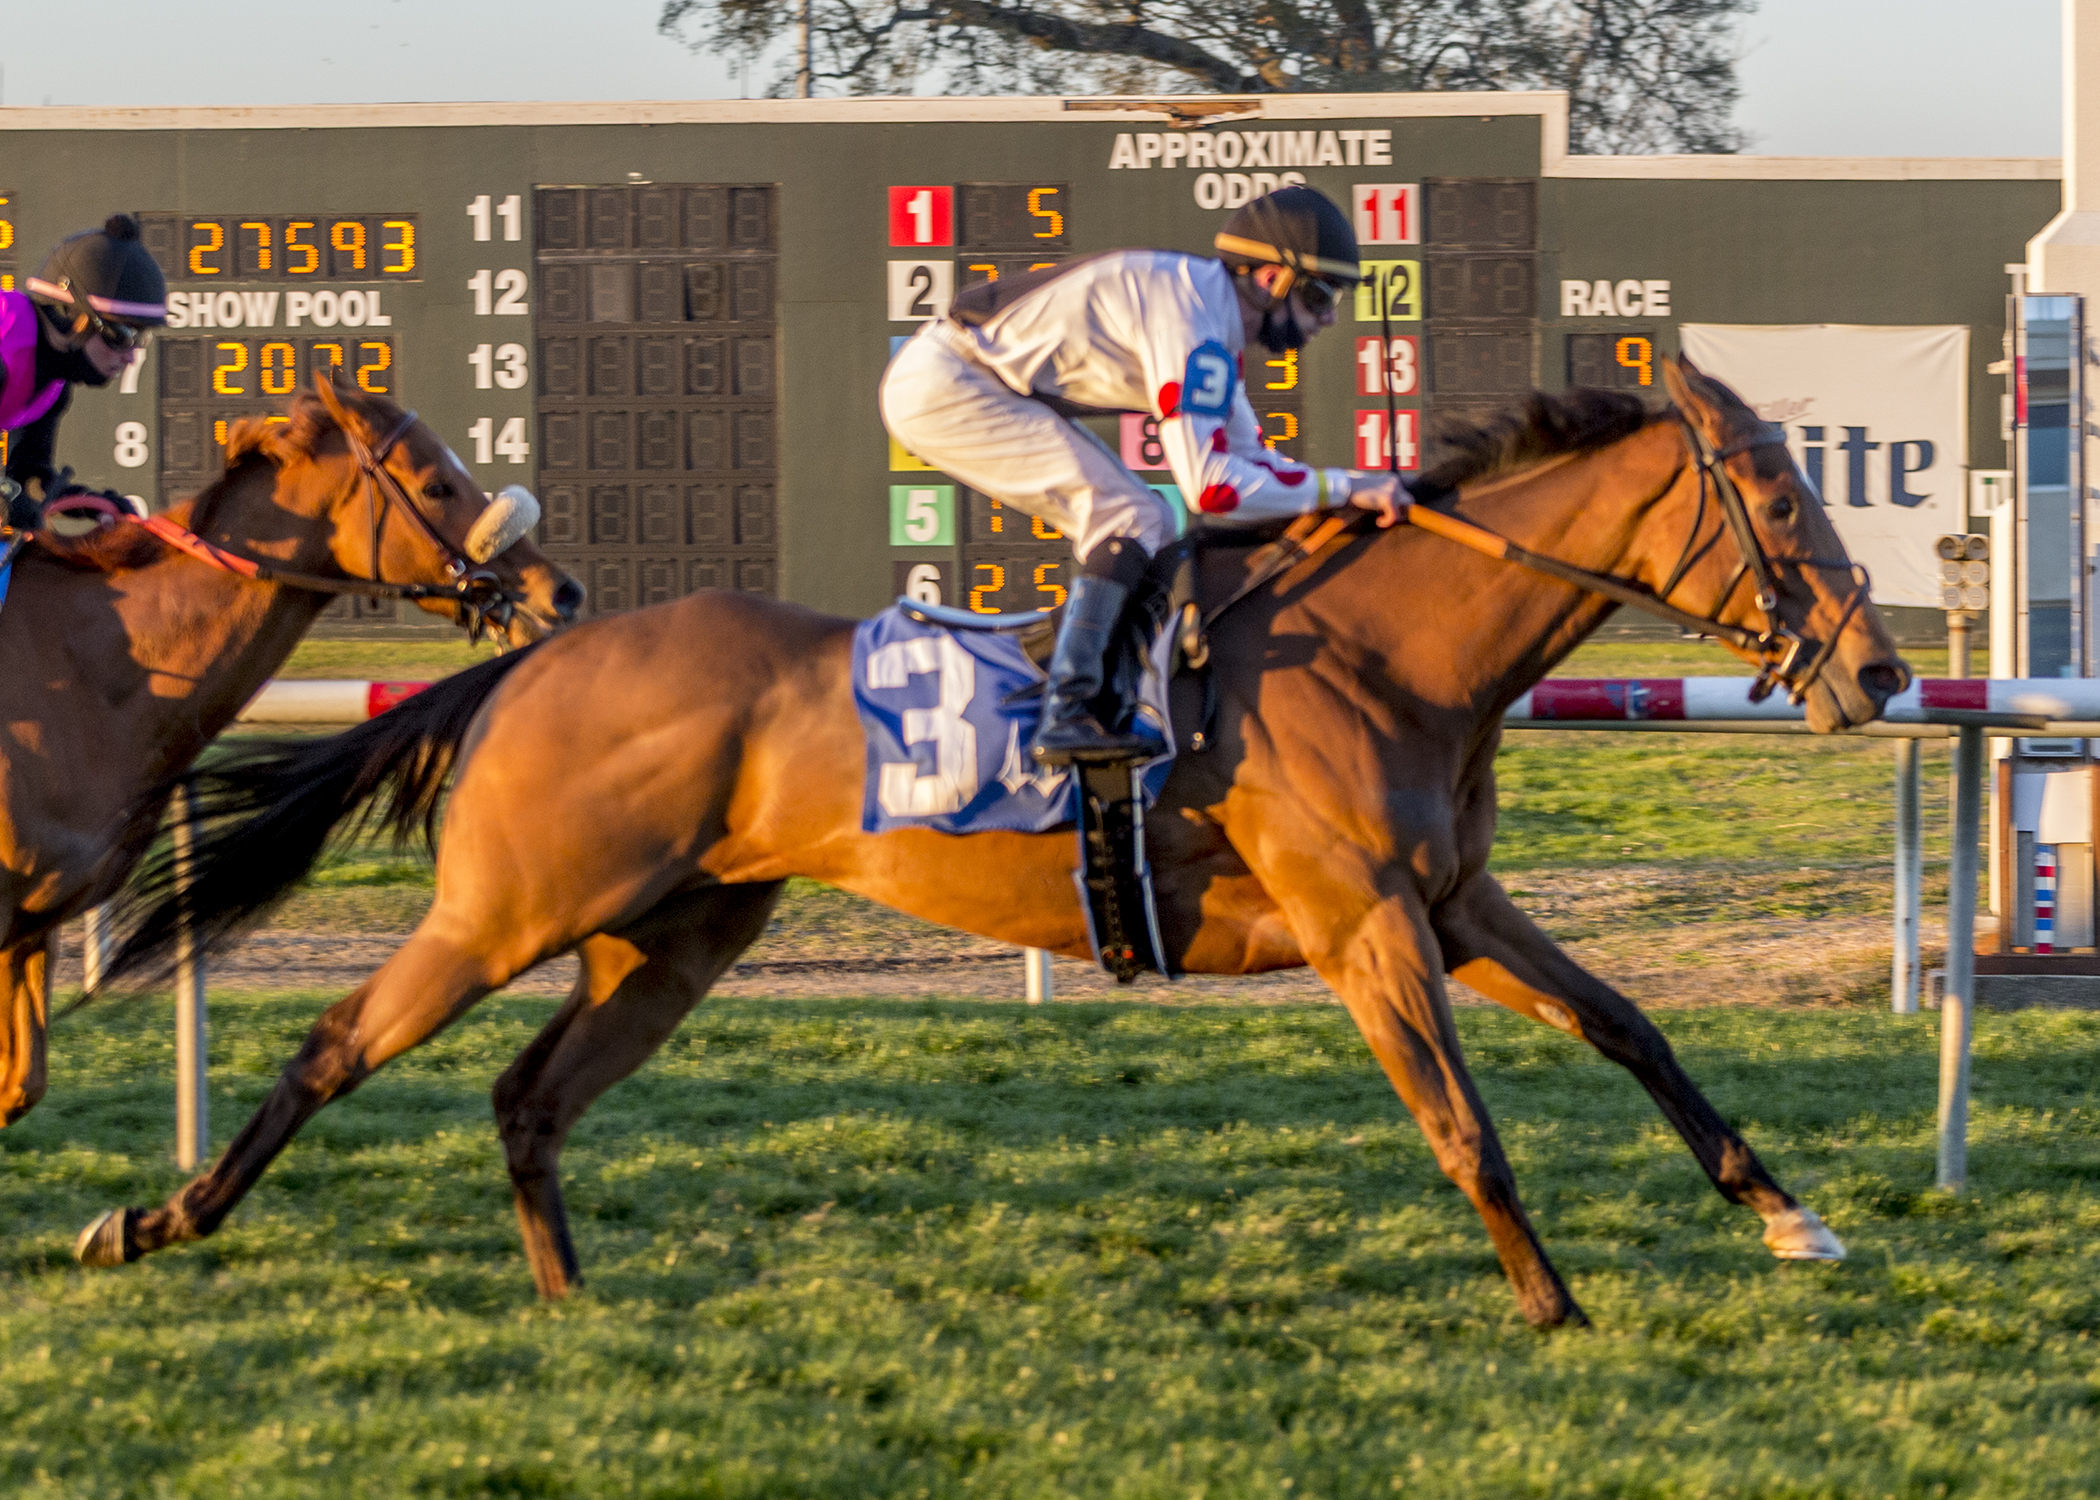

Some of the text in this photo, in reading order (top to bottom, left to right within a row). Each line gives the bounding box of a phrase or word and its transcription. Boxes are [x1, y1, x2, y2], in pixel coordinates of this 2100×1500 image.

[1109, 130, 1392, 169] APPROXIMATE
[466, 195, 522, 241] 11
[906, 191, 933, 243] 1
[1027, 188, 1063, 238] 5
[1362, 188, 1408, 240] 11
[189, 221, 415, 275] 27593
[166, 290, 392, 328] SHOW POOL
[467, 269, 529, 315] 12
[905, 265, 936, 316] 2
[1359, 264, 1411, 316] 12
[1561, 280, 1671, 316] RACE
[468, 343, 529, 389] 13
[1192, 354, 1229, 409] 3
[1358, 339, 1416, 393] 13
[1615, 337, 1652, 386] 9
[114, 421, 149, 467] 8
[468, 417, 530, 463] 14
[1358, 414, 1416, 467] 14
[905, 490, 939, 542] 5
[906, 565, 942, 607] 6
[970, 564, 1068, 614] 25
[867, 635, 979, 817] 3
